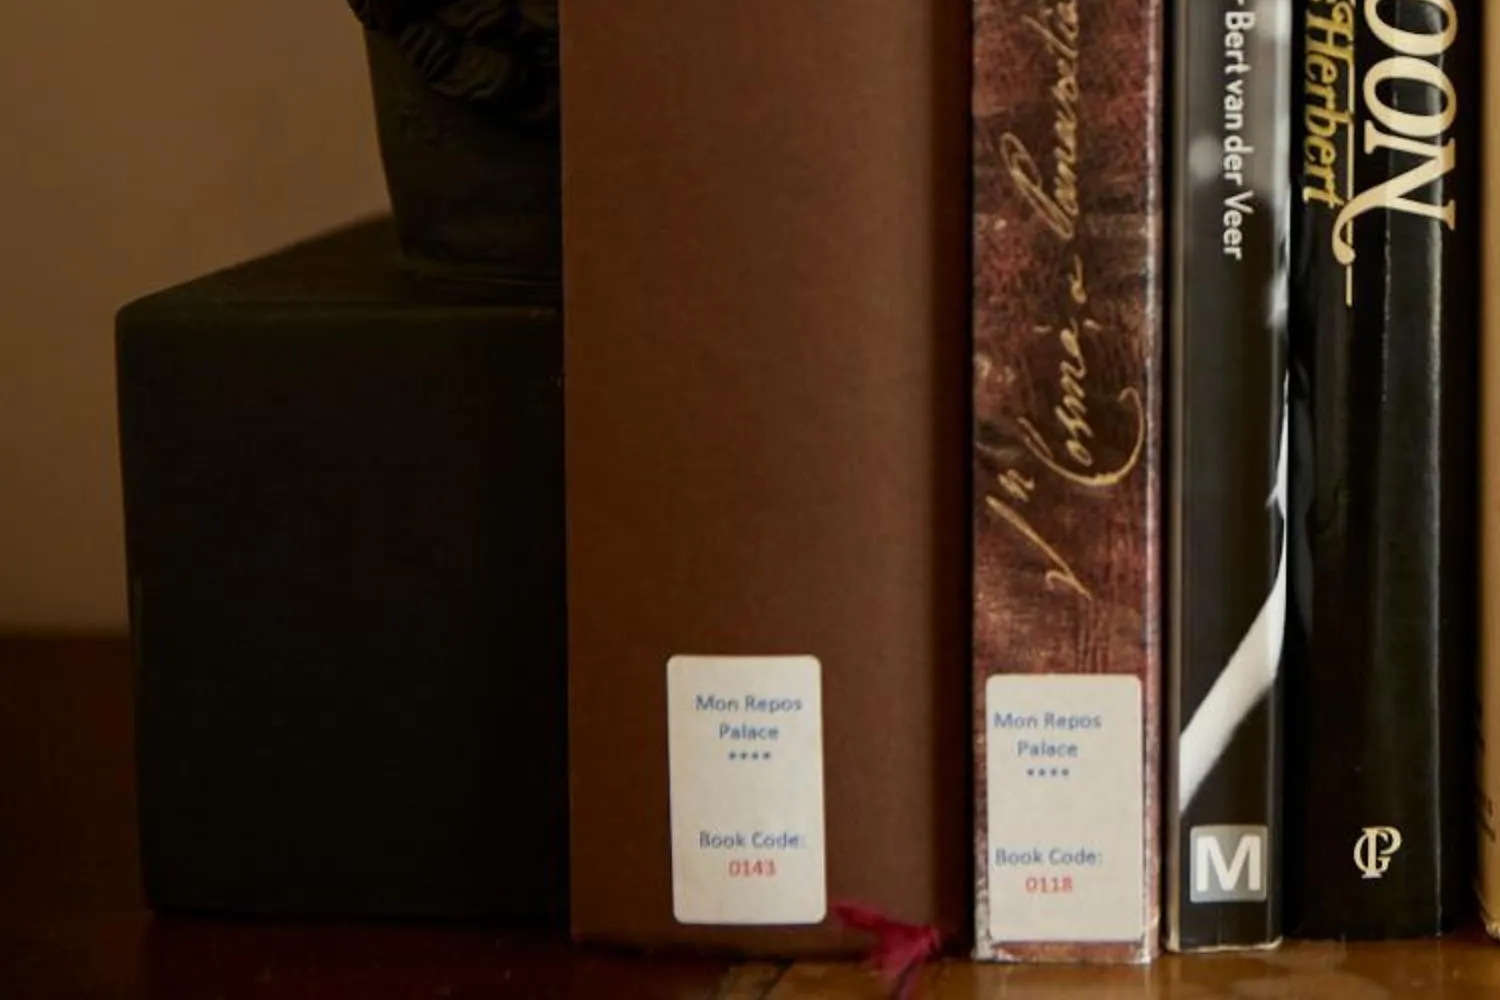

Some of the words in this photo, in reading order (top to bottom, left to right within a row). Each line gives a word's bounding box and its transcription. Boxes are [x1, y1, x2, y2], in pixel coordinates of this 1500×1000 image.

[1225, 11, 1256, 74] Bert
[1224, 79, 1245, 129] van
[1303, 1, 1354, 209] Herbert
[1223, 134, 1254, 186] der
[1222, 190, 1254, 260] Veer
[695, 695, 739, 712] Mon
[744, 695, 803, 715] Repos
[719, 723, 779, 740] Palace
[994, 712, 1038, 729] Mon
[1043, 712, 1102, 732] Repos
[1017, 740, 1078, 757] Palace
[699, 832, 746, 849] Book
[751, 832, 806, 849] Code:
[995, 849, 1043, 866] Book
[1048, 849, 1103, 866] Code:
[1196, 835, 1262, 892] M
[1025, 877, 1073, 894] 0118
